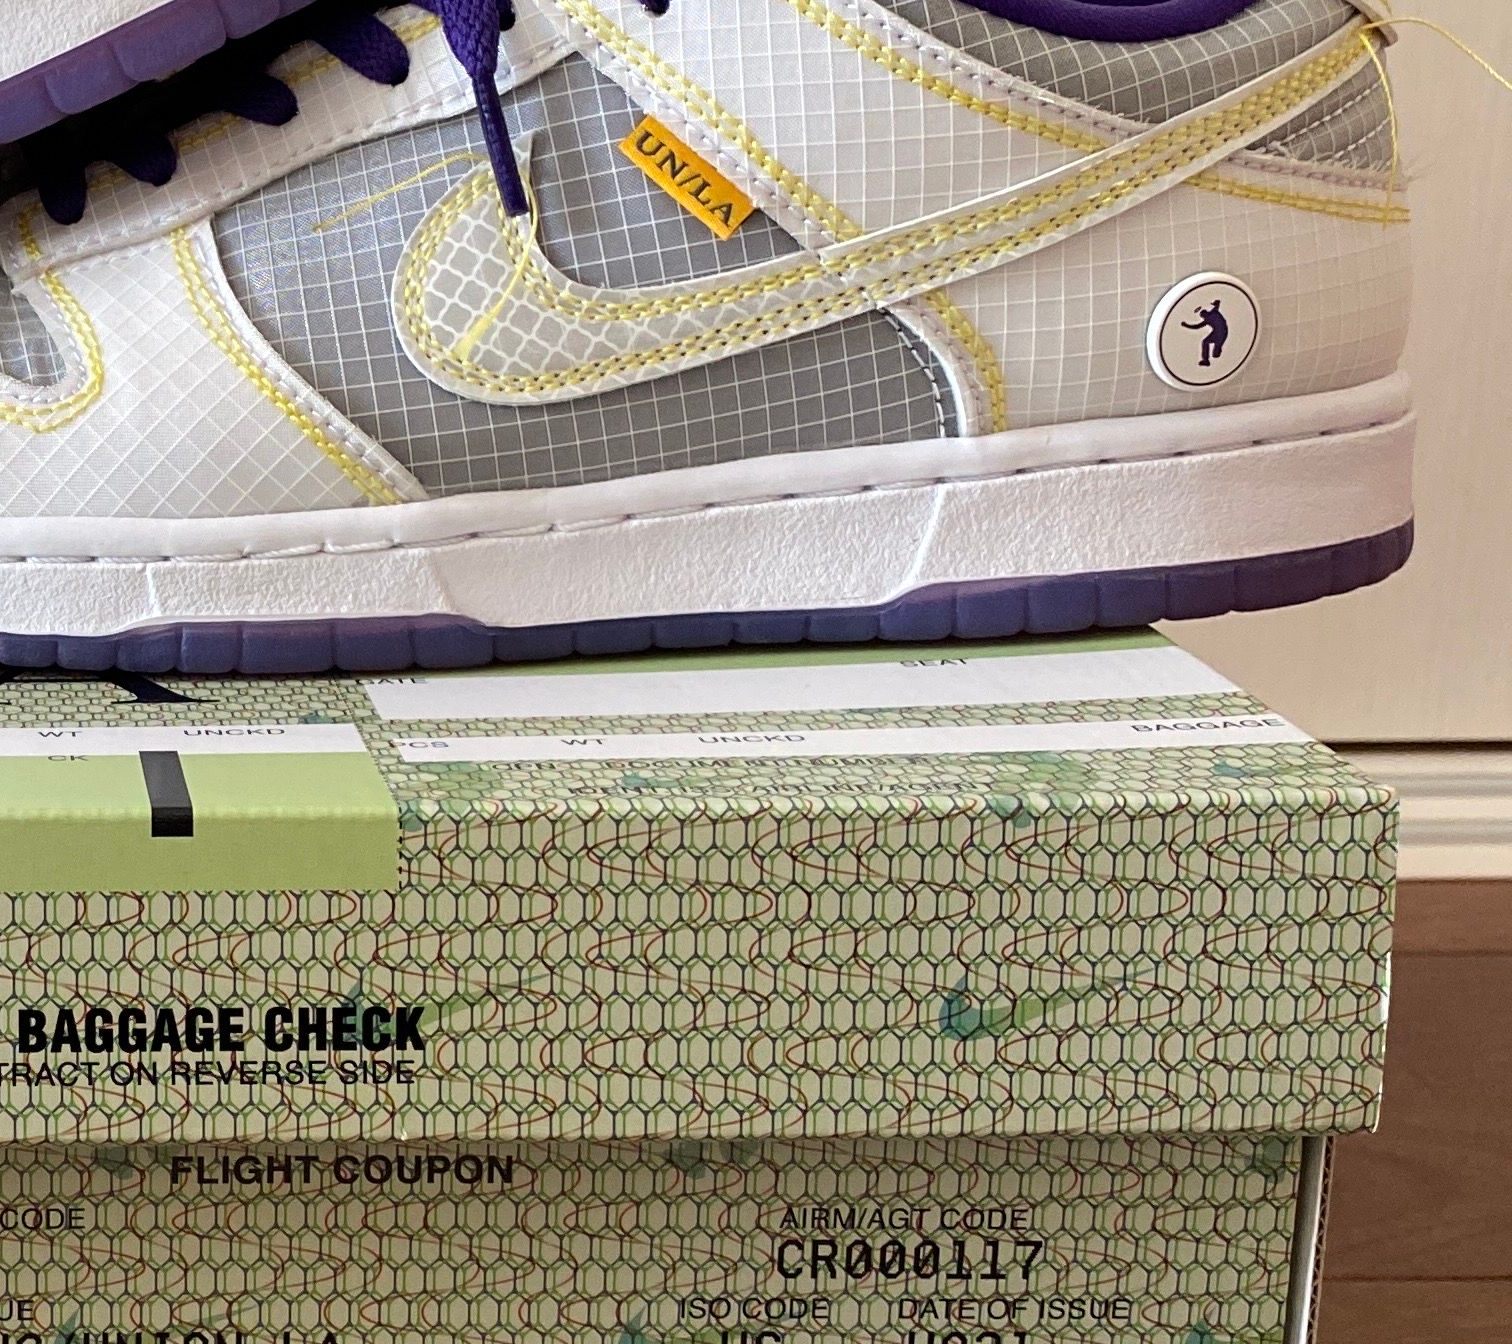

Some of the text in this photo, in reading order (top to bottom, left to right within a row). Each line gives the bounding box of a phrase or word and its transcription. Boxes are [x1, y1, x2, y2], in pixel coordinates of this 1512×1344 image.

[635, 130, 733, 231] UN/LA
[899, 657, 969, 668] SEAT
[38, 730, 83, 738] WT
[183, 728, 286, 736] UNCKD
[388, 718, 1287, 749] PCS WT UNCKD BAGGAGE
[47, 754, 89, 762] CK
[18, 1007, 245, 1054] BAGGAGE
[264, 1005, 426, 1052] CHECK
[109, 1061, 159, 1087] ON
[170, 1059, 328, 1087] REVERSE
[337, 1059, 416, 1086] SIDE
[169, 1155, 515, 1186] FLIGHT COUPON
[0, 1207, 86, 1231] CODE
[779, 1207, 1030, 1231] AIRM/AGT CODE
[776, 1239, 1044, 1281] CR000117
[679, 1297, 831, 1320] ISO CODE
[898, 1297, 1132, 1320] DATE OF ISSUE
